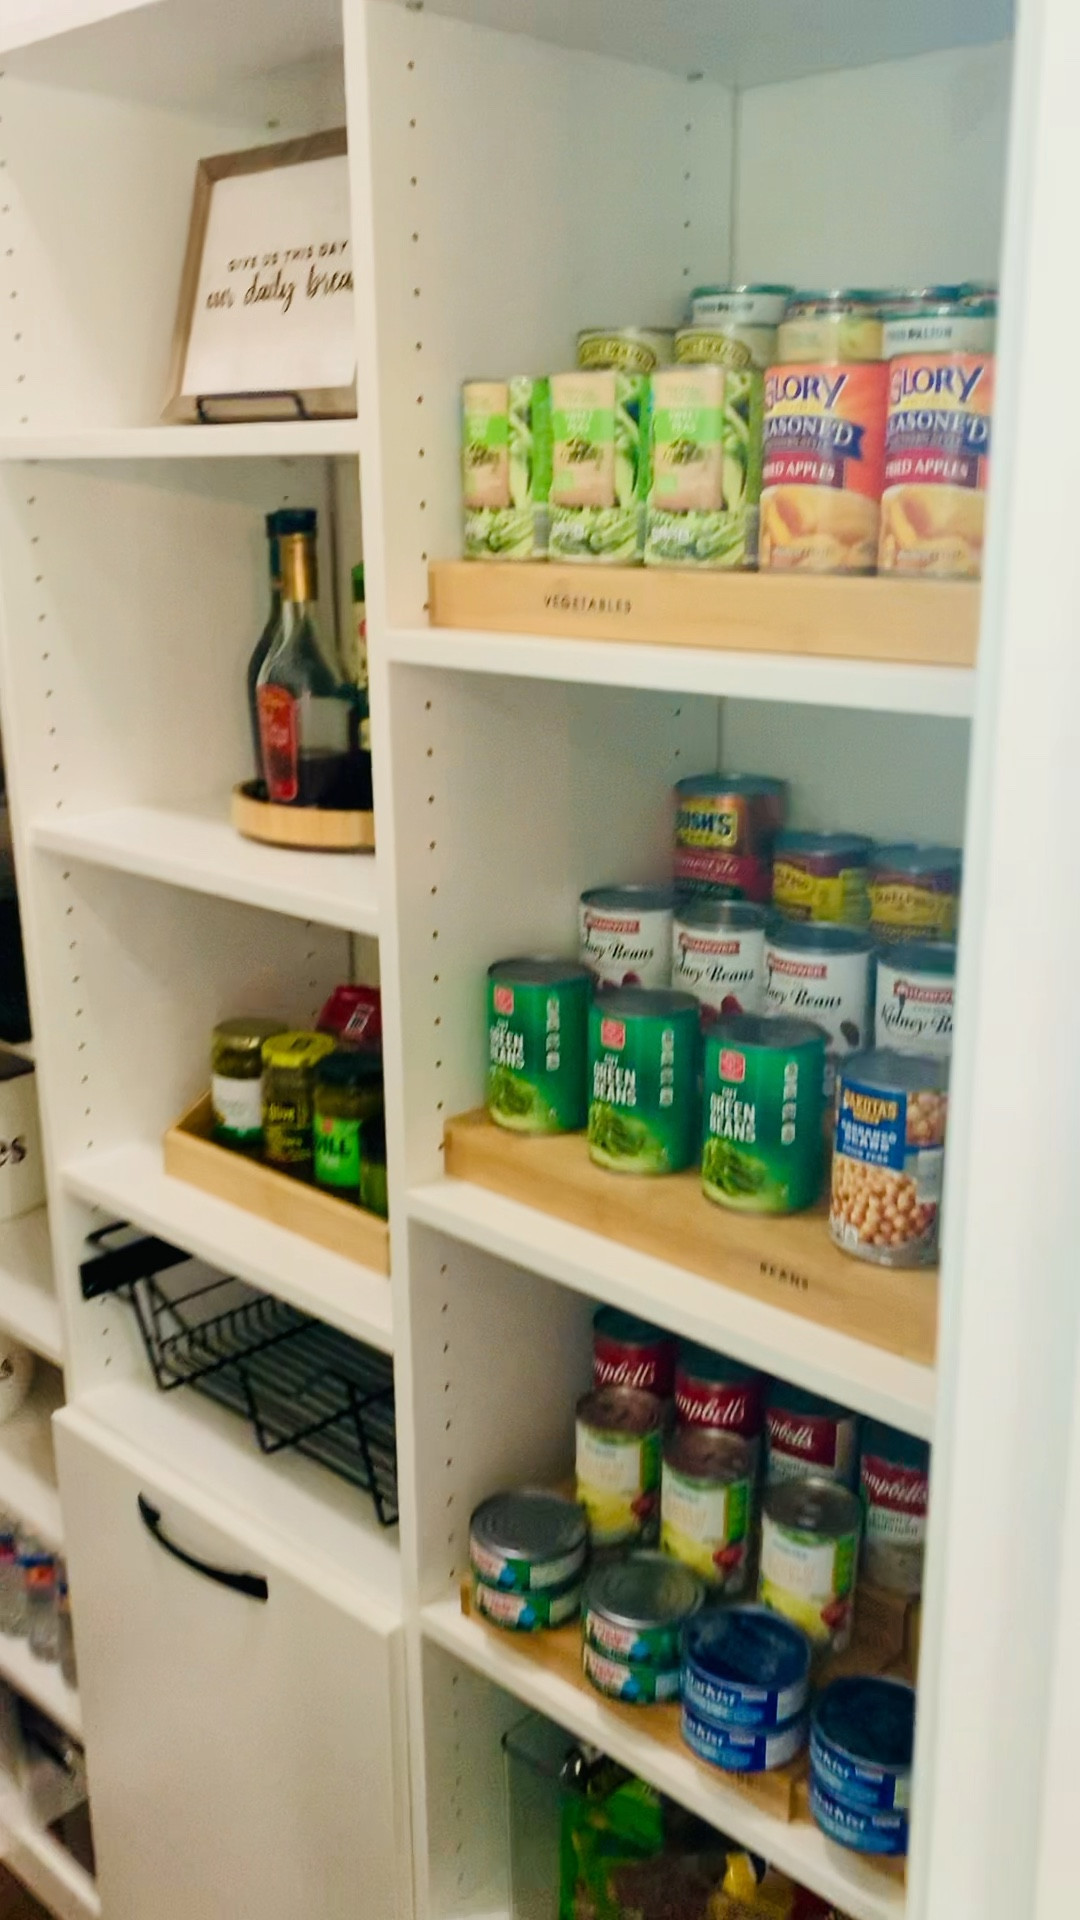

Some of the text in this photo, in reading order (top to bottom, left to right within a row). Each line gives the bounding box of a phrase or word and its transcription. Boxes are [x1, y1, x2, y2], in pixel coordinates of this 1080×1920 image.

[227, 240, 348, 272] GIVE US THIS DAY
[244, 269, 295, 314] daily
[766, 373, 849, 410] GLORY
[890, 366, 985, 404] GLORY
[544, 594, 632, 615] VEGETABLES
[609, 943, 653, 961] Beans
[707, 964, 754, 983] Beans
[791, 989, 841, 1008] Beans
[593, 1060, 636, 1088] GREEN
[593, 1077, 637, 1107] BEANS
[710, 1092, 755, 1121] GREEN
[710, 1112, 756, 1143] BEANS
[759, 1261, 809, 1291] BEANS
